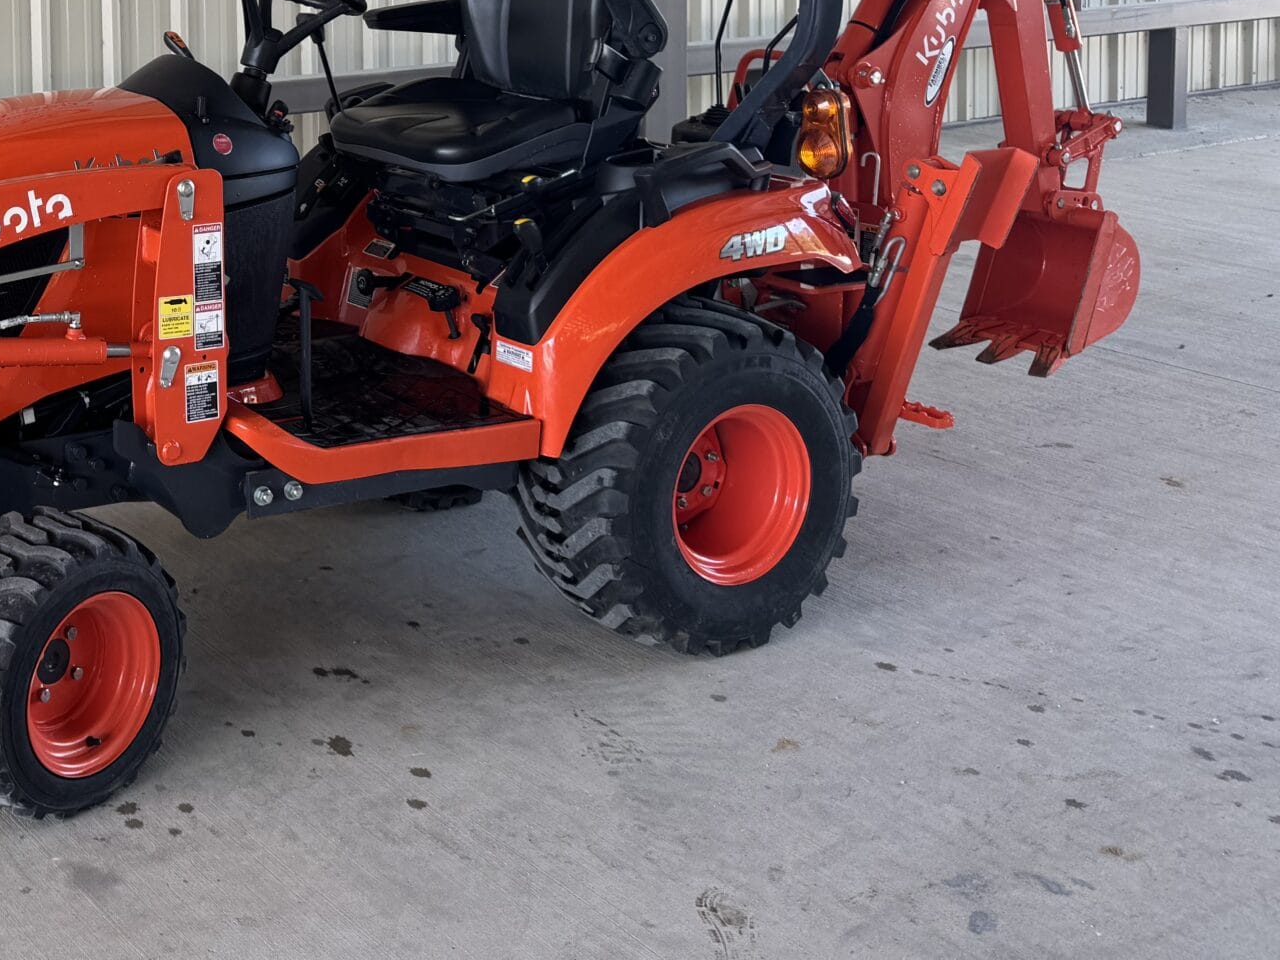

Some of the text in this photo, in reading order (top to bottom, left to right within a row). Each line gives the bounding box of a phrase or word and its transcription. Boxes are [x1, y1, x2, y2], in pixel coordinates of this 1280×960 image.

[198, 224, 221, 233] DANGER
[720, 223, 789, 262] 4WD
[200, 303, 222, 312] DANGER
